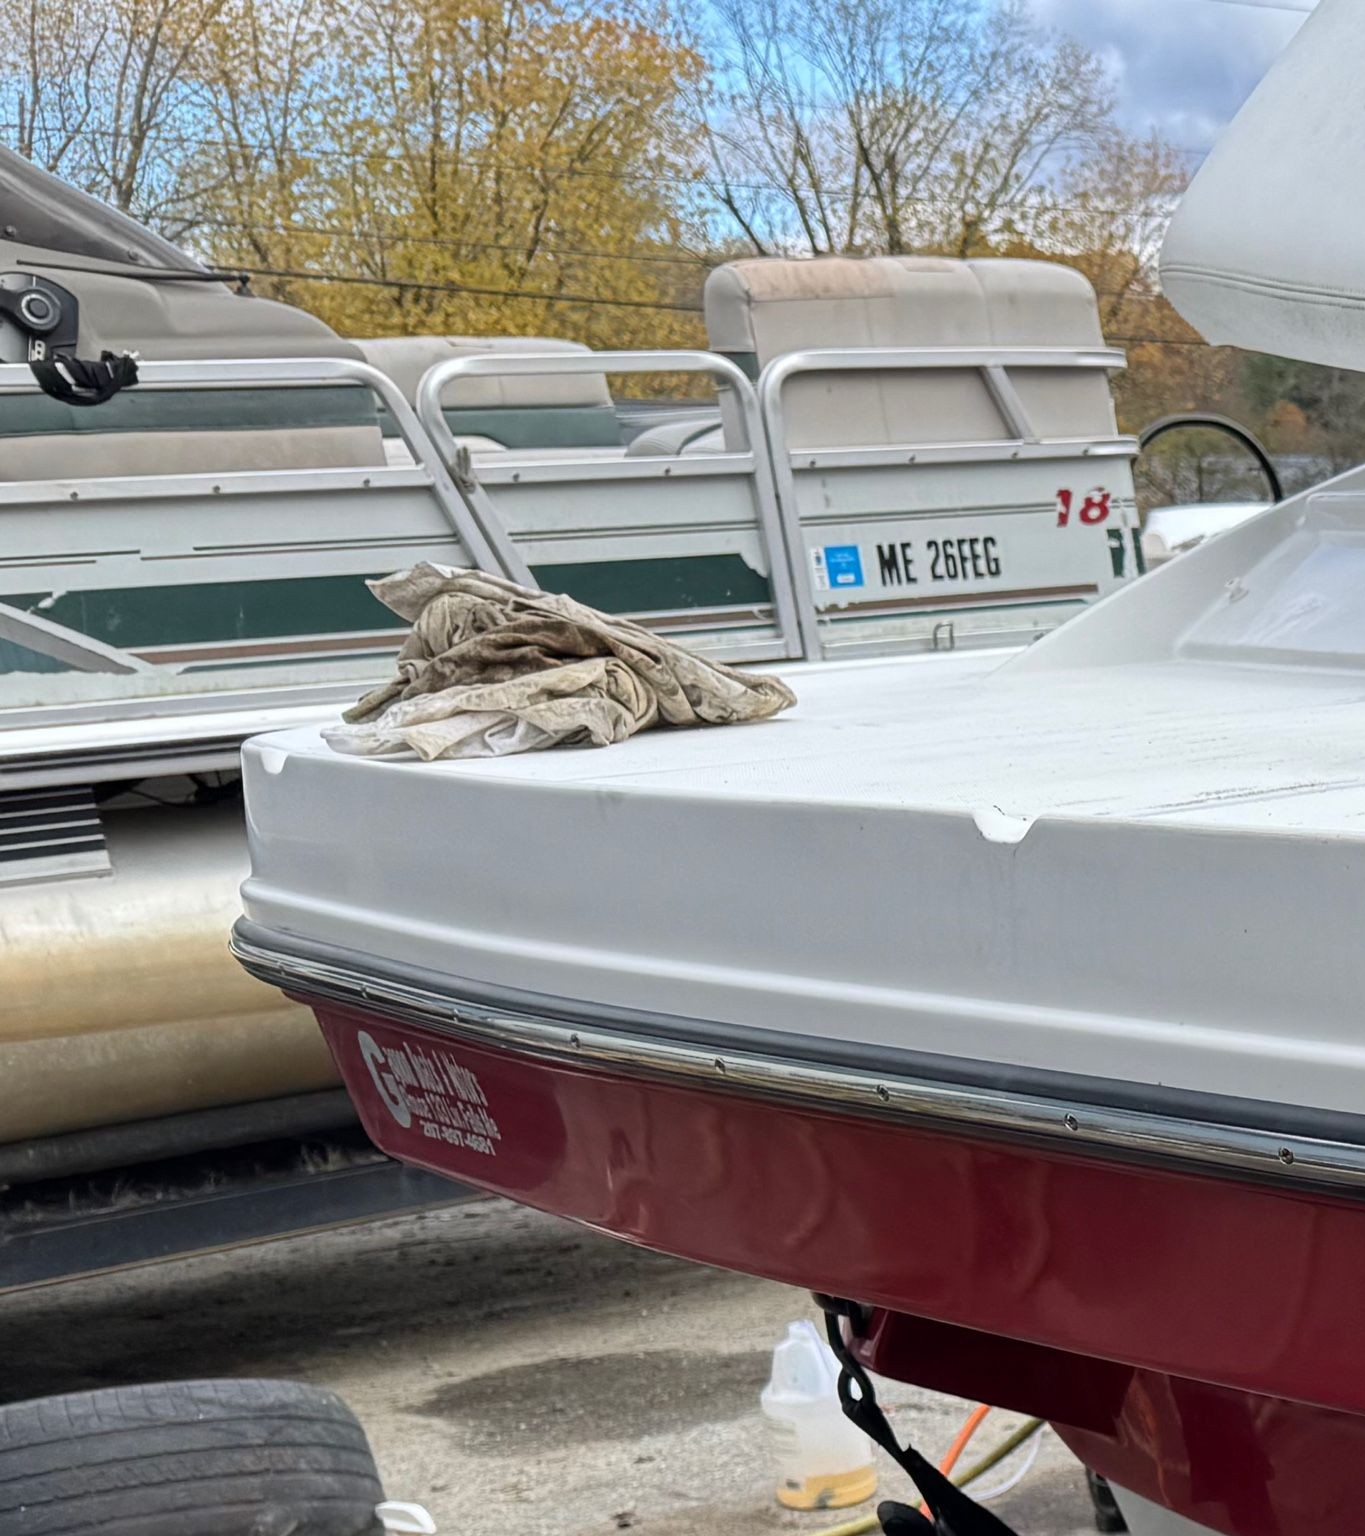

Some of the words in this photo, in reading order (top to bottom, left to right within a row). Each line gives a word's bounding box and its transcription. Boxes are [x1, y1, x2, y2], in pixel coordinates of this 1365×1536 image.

[1056, 486, 1111, 528] 18
[876, 542, 918, 587] ME
[927, 536, 1002, 582] 26FEG
